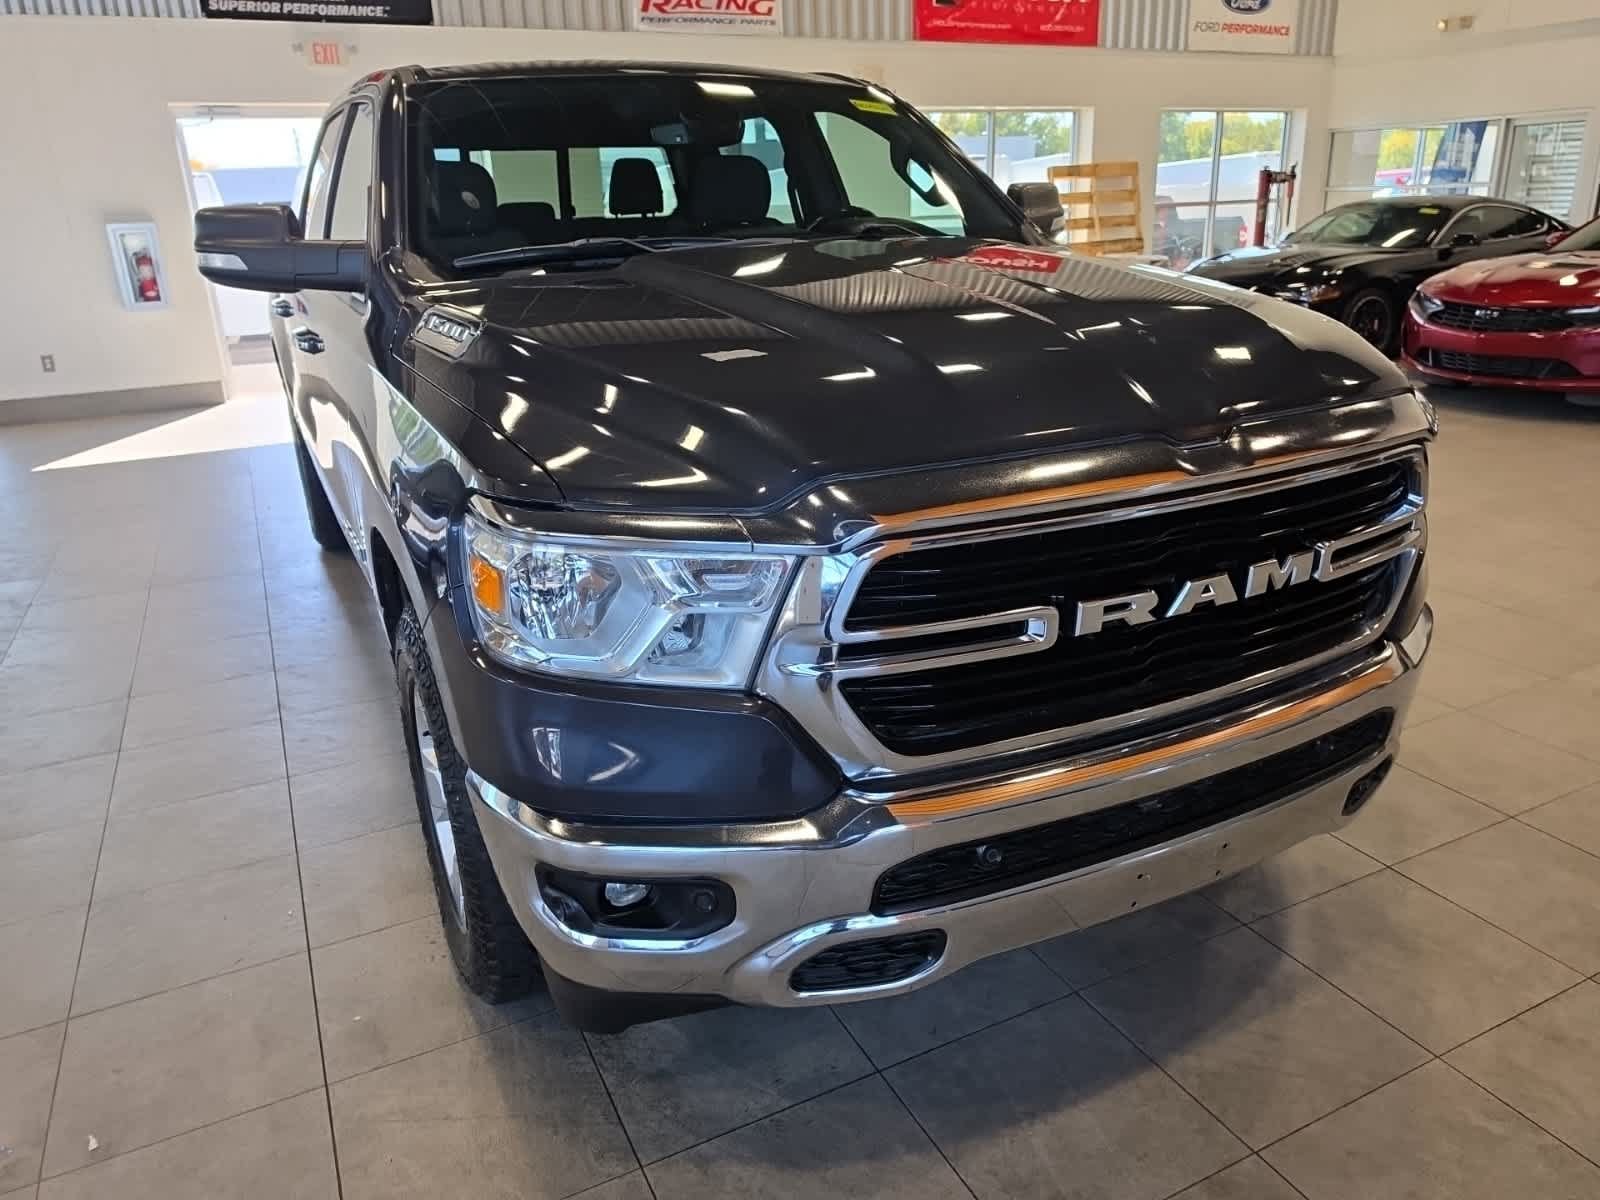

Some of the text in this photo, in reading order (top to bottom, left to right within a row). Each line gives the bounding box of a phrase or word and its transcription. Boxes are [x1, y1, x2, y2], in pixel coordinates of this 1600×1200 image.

[208, 0, 281, 14] SUPERIOR
[641, 0, 775, 16] RACING
[641, 16, 776, 26] PERFORMANCE PARTS
[1193, 21, 1290, 36] FORD PERFORMANCE
[312, 42, 341, 65] EXIT
[1074, 550, 1315, 637] RAM
